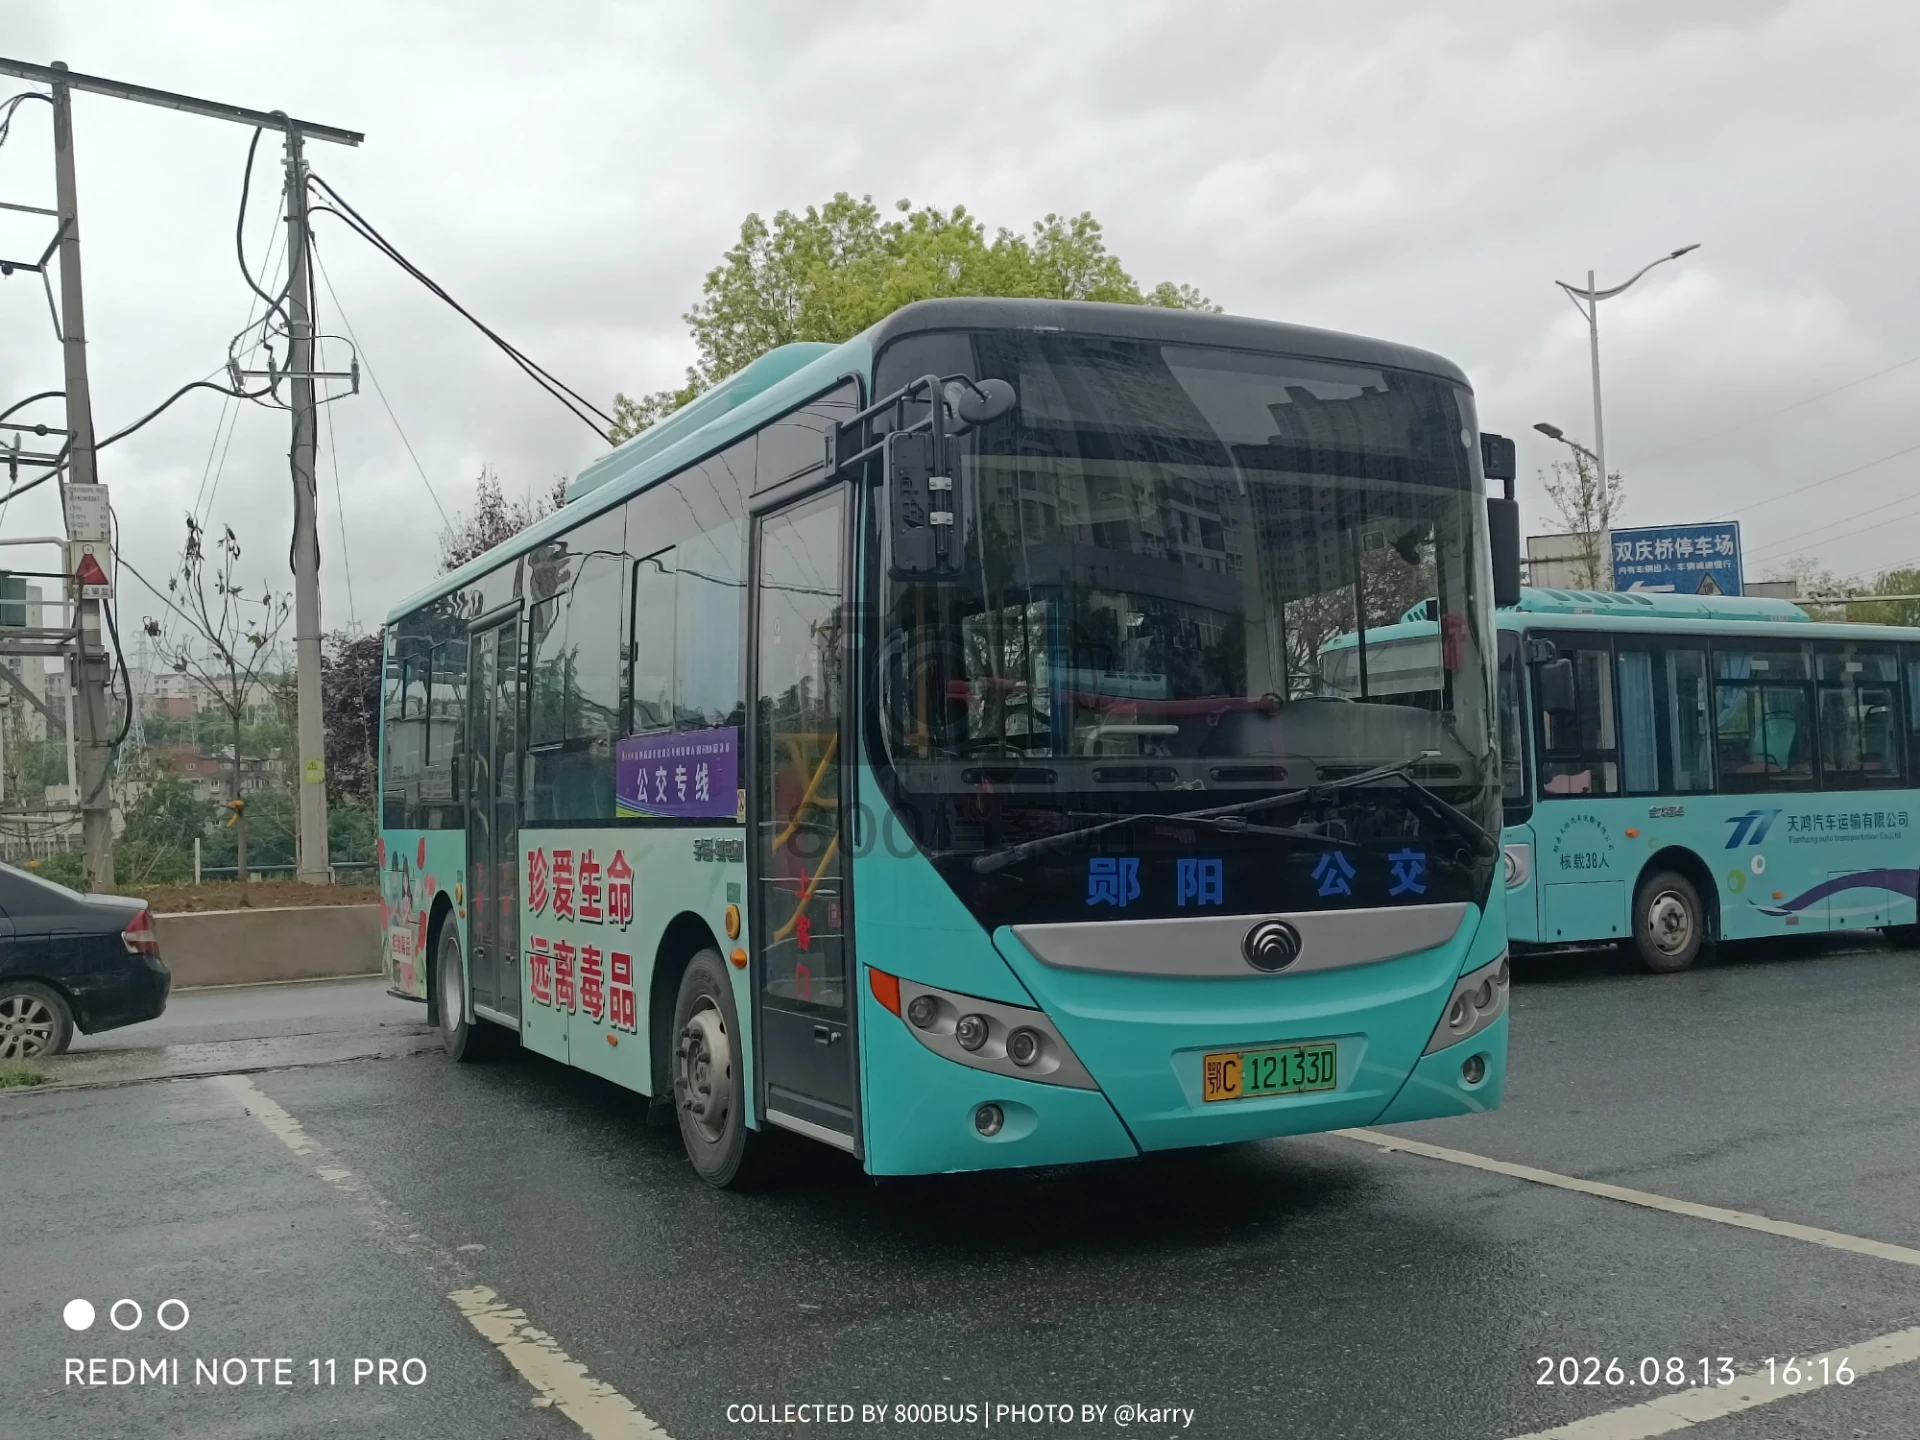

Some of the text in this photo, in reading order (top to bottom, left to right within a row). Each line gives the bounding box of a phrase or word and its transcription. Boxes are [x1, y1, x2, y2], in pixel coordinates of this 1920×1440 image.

[1614, 534, 1734, 562] 双庆桥停车场
[637, 762, 710, 803] 公交专线
[1787, 811, 1909, 832] 天鸿汽车运输有限公司
[1085, 847, 1428, 908] 郧阳 公交
[1560, 852, 1610, 870] 核载38人
[528, 847, 635, 933] 珍爱生命
[529, 935, 637, 1035] 远离毒品
[1207, 1050, 1334, 1094] 鄂C 12133D
